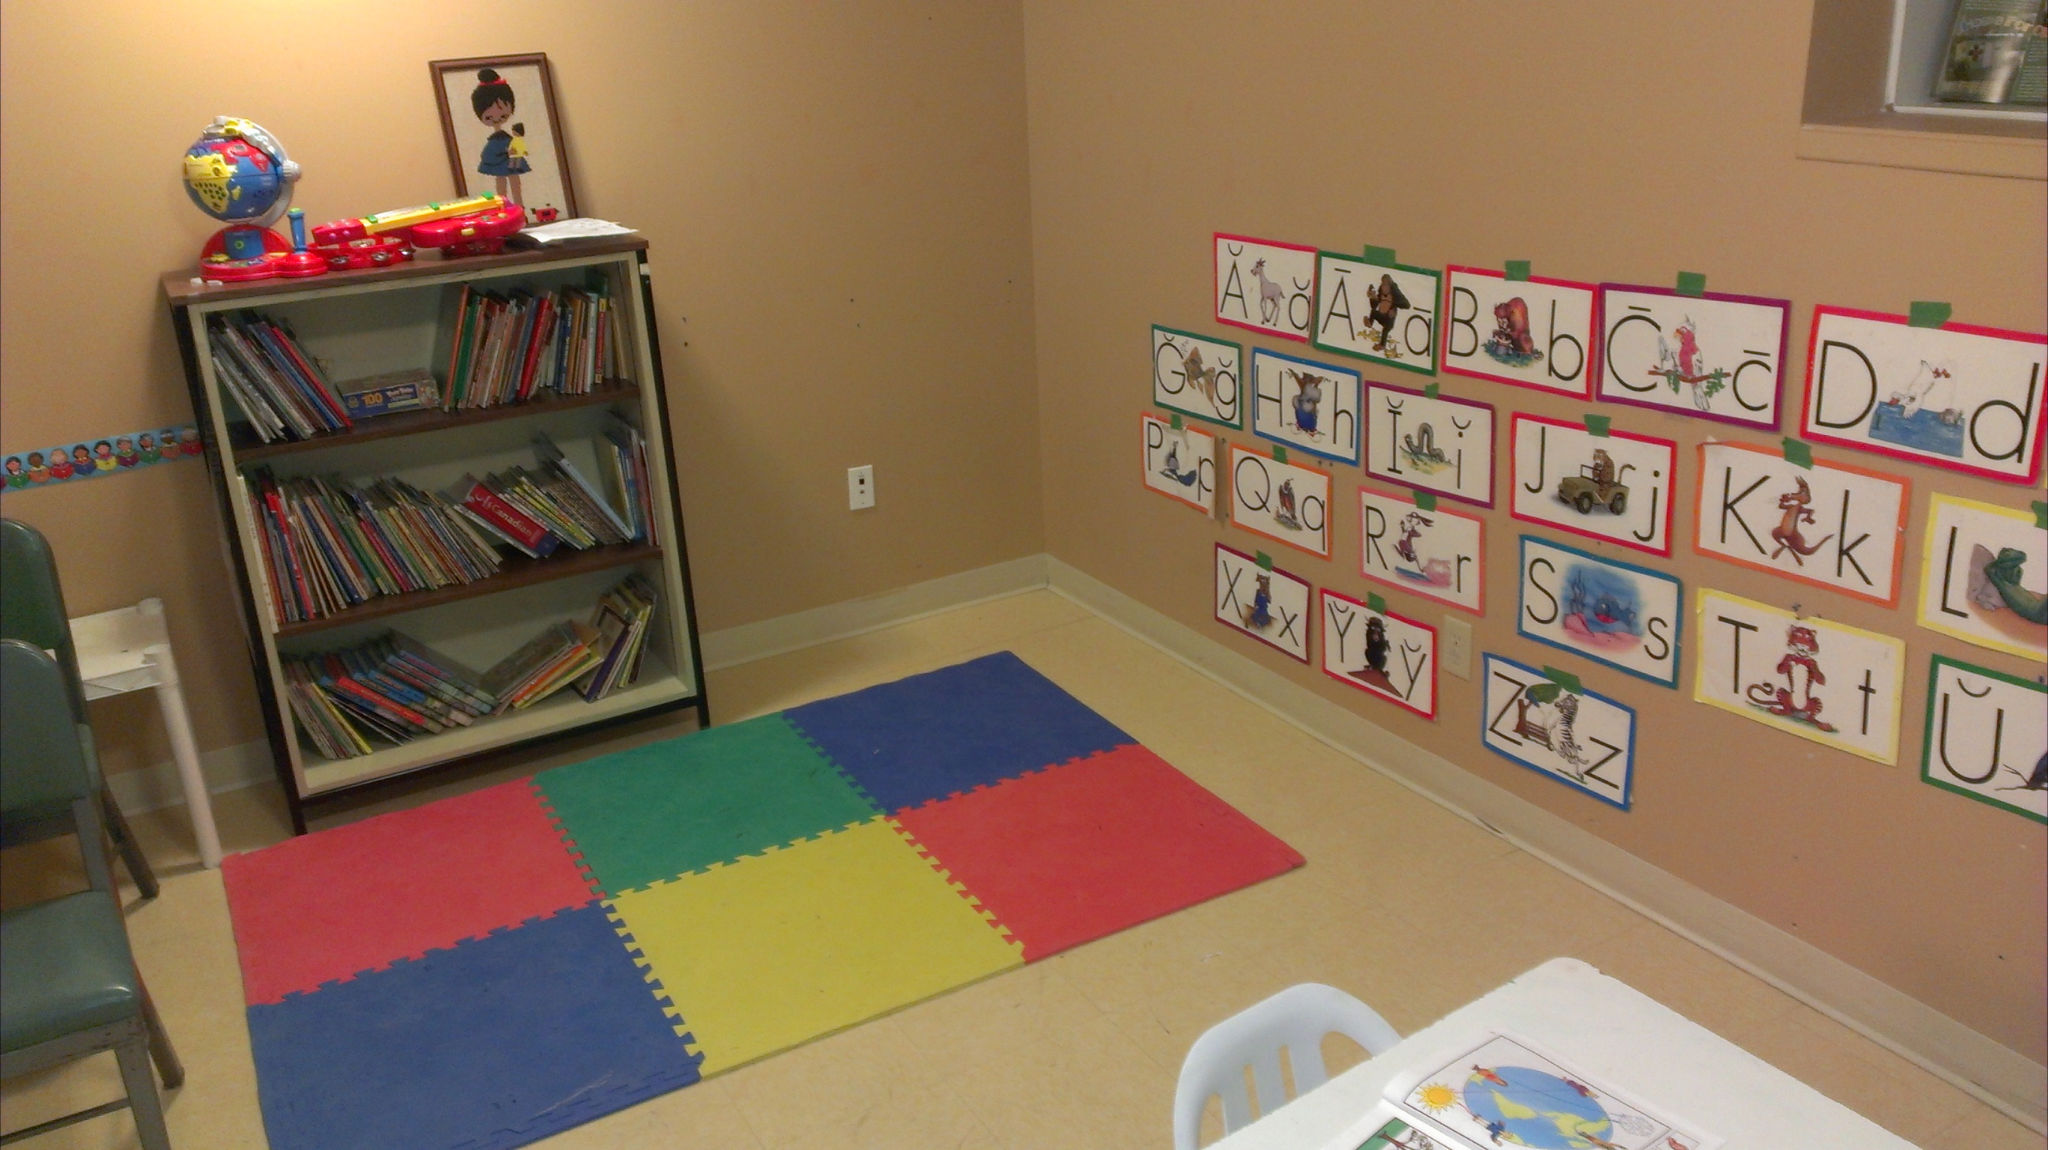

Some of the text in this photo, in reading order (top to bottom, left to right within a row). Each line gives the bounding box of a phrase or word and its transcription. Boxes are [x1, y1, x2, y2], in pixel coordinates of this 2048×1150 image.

[1449, 286, 1584, 381] B b
[1255, 364, 1354, 450] H h
[1815, 340, 2040, 464] D d
[1147, 421, 1214, 501] P p
[1234, 456, 1326, 552] Q q
[1524, 426, 1660, 542] J j
[1366, 505, 1471, 593] R r
[1720, 467, 1873, 586] K k
[1941, 526, 1969, 619] L
[1222, 560, 1299, 648] X x
[1526, 557, 1670, 661] S s
[1718, 615, 1876, 735] T t
[1488, 671, 1622, 790] Z z
